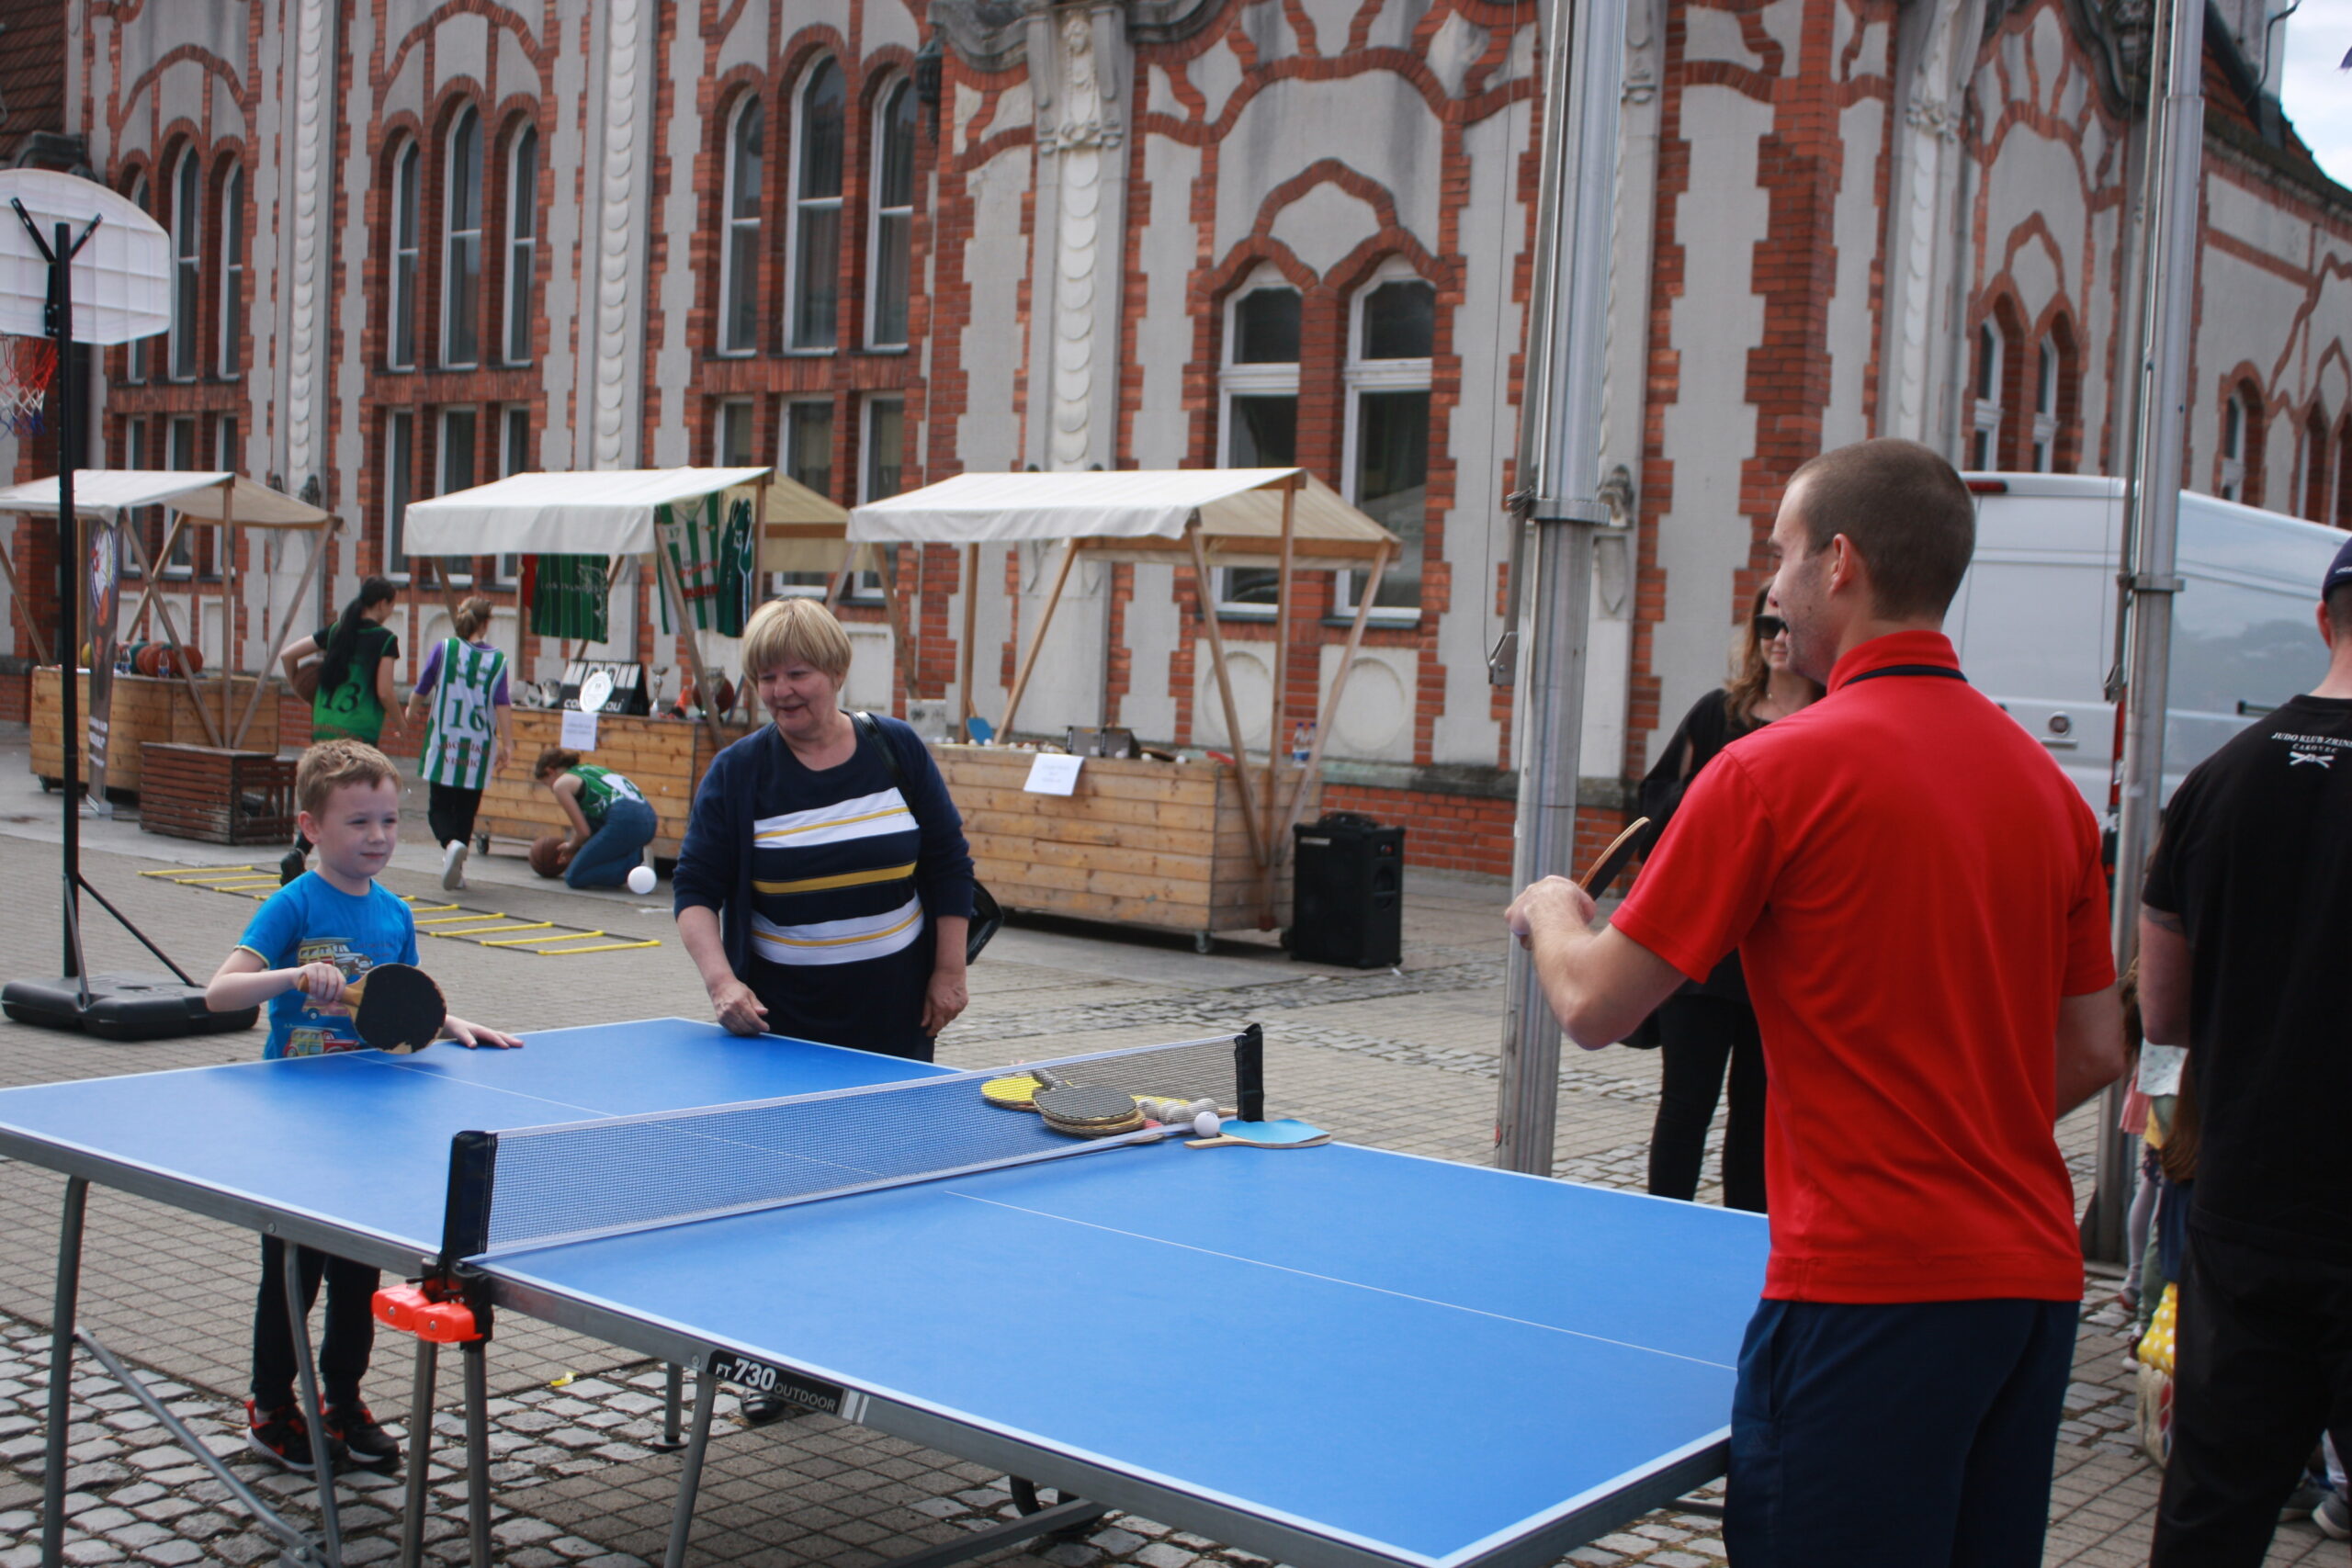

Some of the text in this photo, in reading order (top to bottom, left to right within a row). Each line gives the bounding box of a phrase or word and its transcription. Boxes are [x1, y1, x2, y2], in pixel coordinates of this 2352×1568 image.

[448, 698, 486, 732] 16
[2271, 732, 2299, 741] JUDO
[2299, 734, 2324, 743] KLUB
[715, 1357, 837, 1413] FT 730 OUTDOOR
